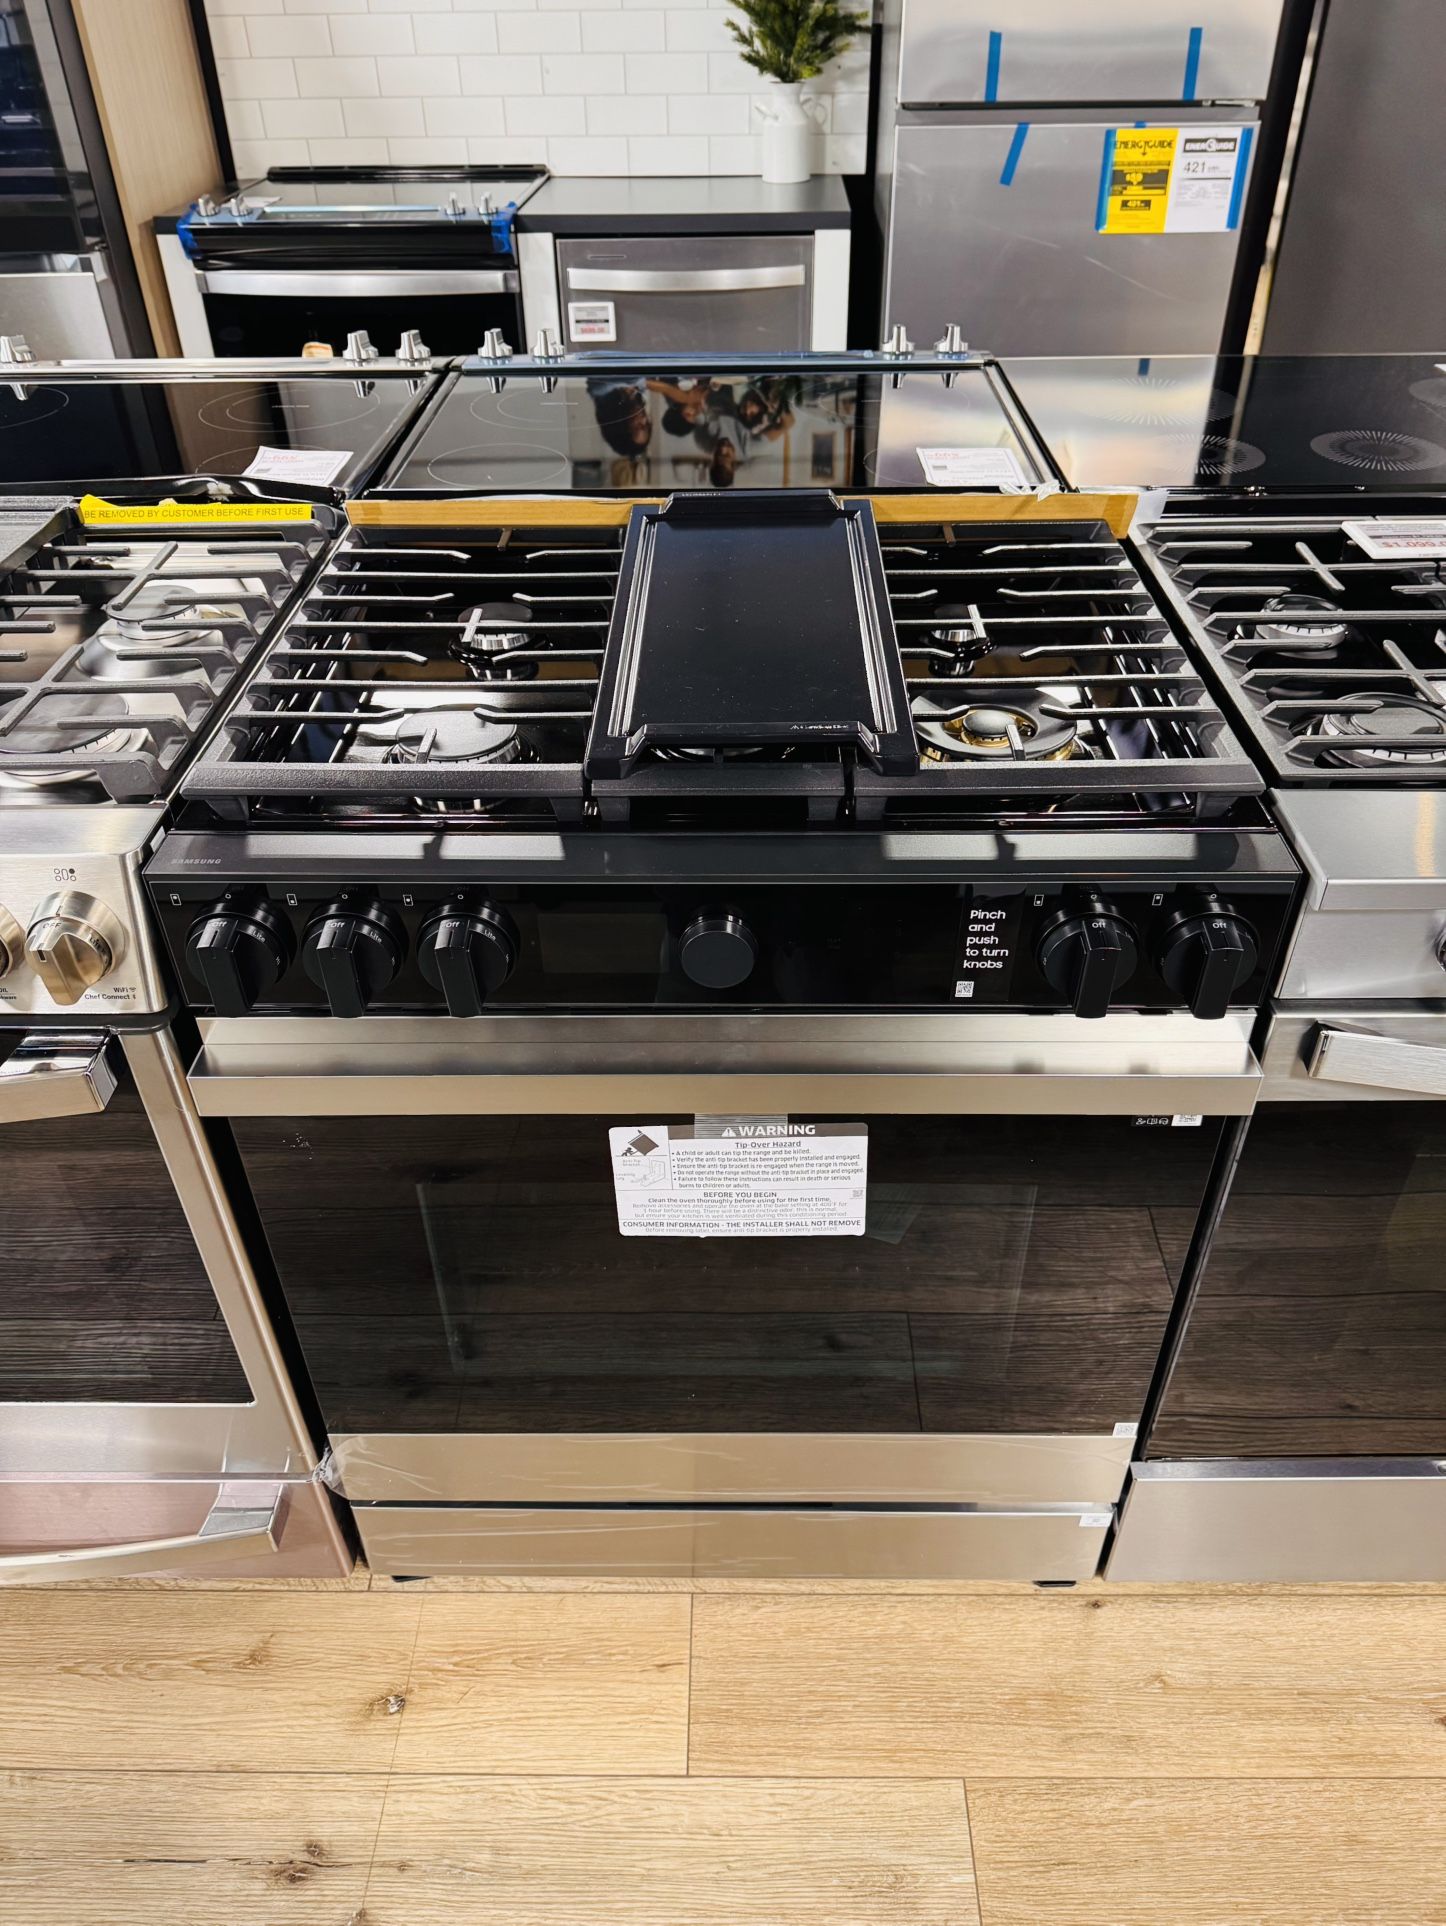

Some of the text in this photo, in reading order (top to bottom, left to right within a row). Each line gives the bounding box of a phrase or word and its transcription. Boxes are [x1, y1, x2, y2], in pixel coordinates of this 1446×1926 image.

[1184, 161, 1206, 173] 421
[84, 510, 96, 518] BE
[161, 509, 214, 517] CUSTOMER
[216, 508, 254, 516] BEFORE
[969, 909, 1006, 920] Pinch
[968, 922, 996, 932] and
[1091, 921, 1106, 929] Off
[966, 935, 999, 947] push
[965, 947, 1009, 957] to turn
[963, 959, 1004, 969] knobs
[738, 1124, 816, 1137] WARNING
[735, 1140, 801, 1149] Tip-Over Hazard
